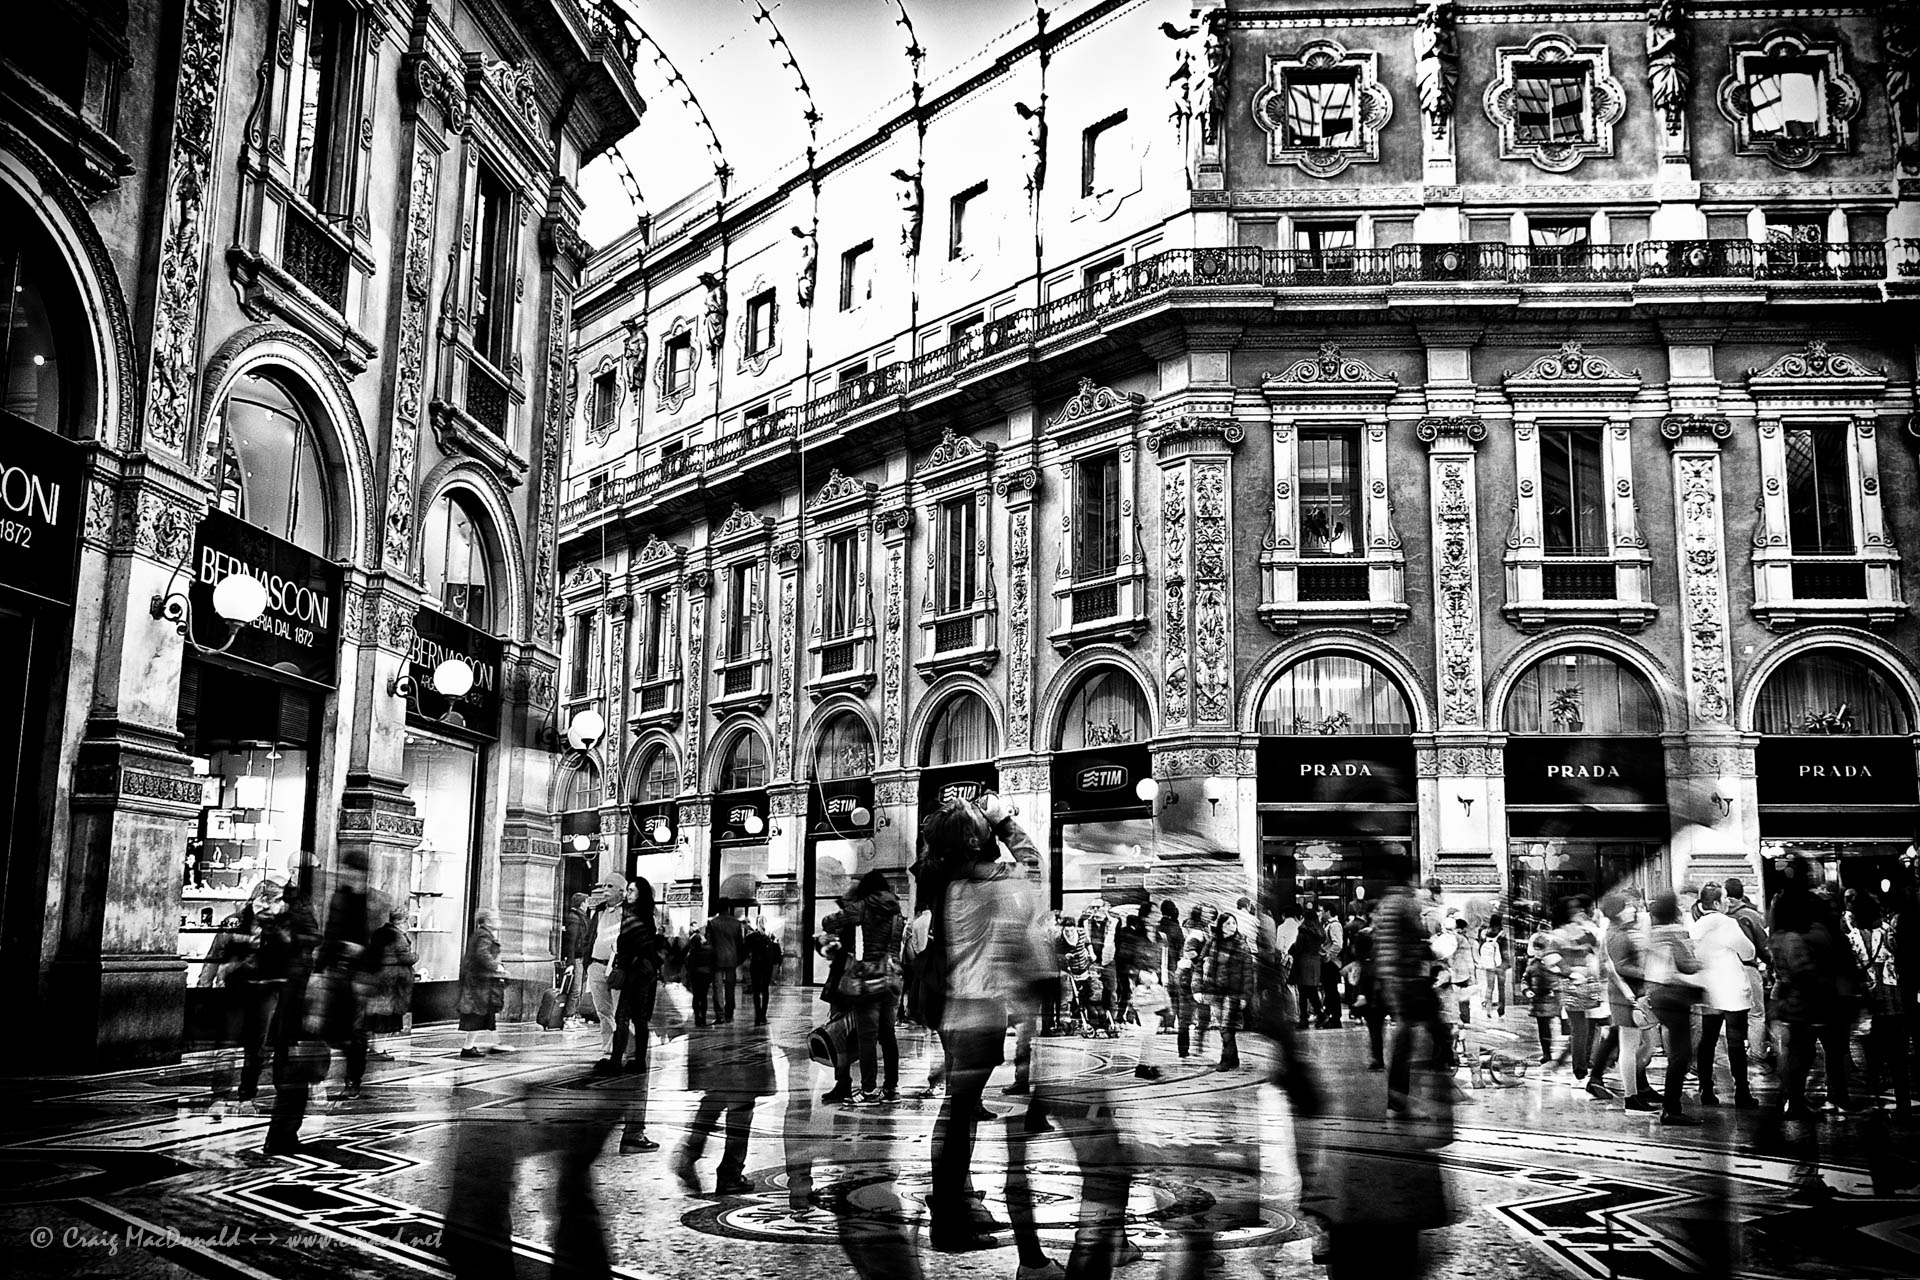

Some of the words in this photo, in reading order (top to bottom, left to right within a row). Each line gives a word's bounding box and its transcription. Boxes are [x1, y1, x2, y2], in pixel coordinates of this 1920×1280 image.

[0, 462, 60, 526] ONI
[0, 518, 32, 548] 1872
[274, 619, 292, 640] DAL
[294, 626, 314, 648] 1872
[1300, 763, 1371, 776] PRADA
[1547, 765, 1619, 777] PRADA
[1799, 765, 1871, 777] PRADA
[1100, 769, 1122, 786] TIM
[958, 785, 976, 800] TIM
[840, 799, 856, 812] TIM
